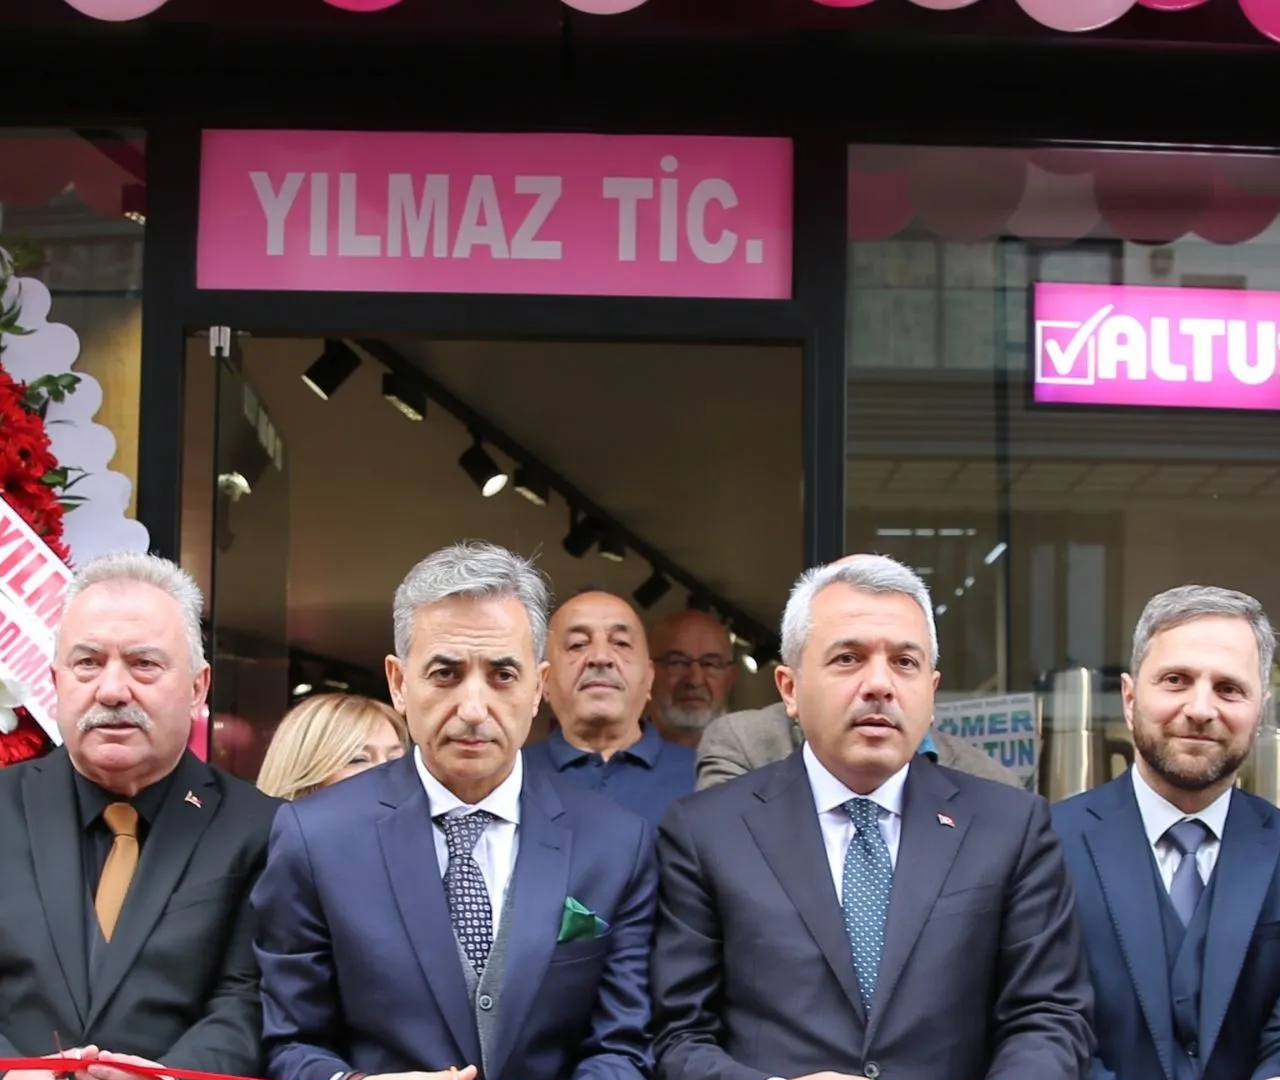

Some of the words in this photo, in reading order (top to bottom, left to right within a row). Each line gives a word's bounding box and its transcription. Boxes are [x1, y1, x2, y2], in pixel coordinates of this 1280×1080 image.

[248, 171, 563, 260] YILMAZ
[602, 155, 763, 264] TİC.
[972, 738, 1035, 768] TUN
